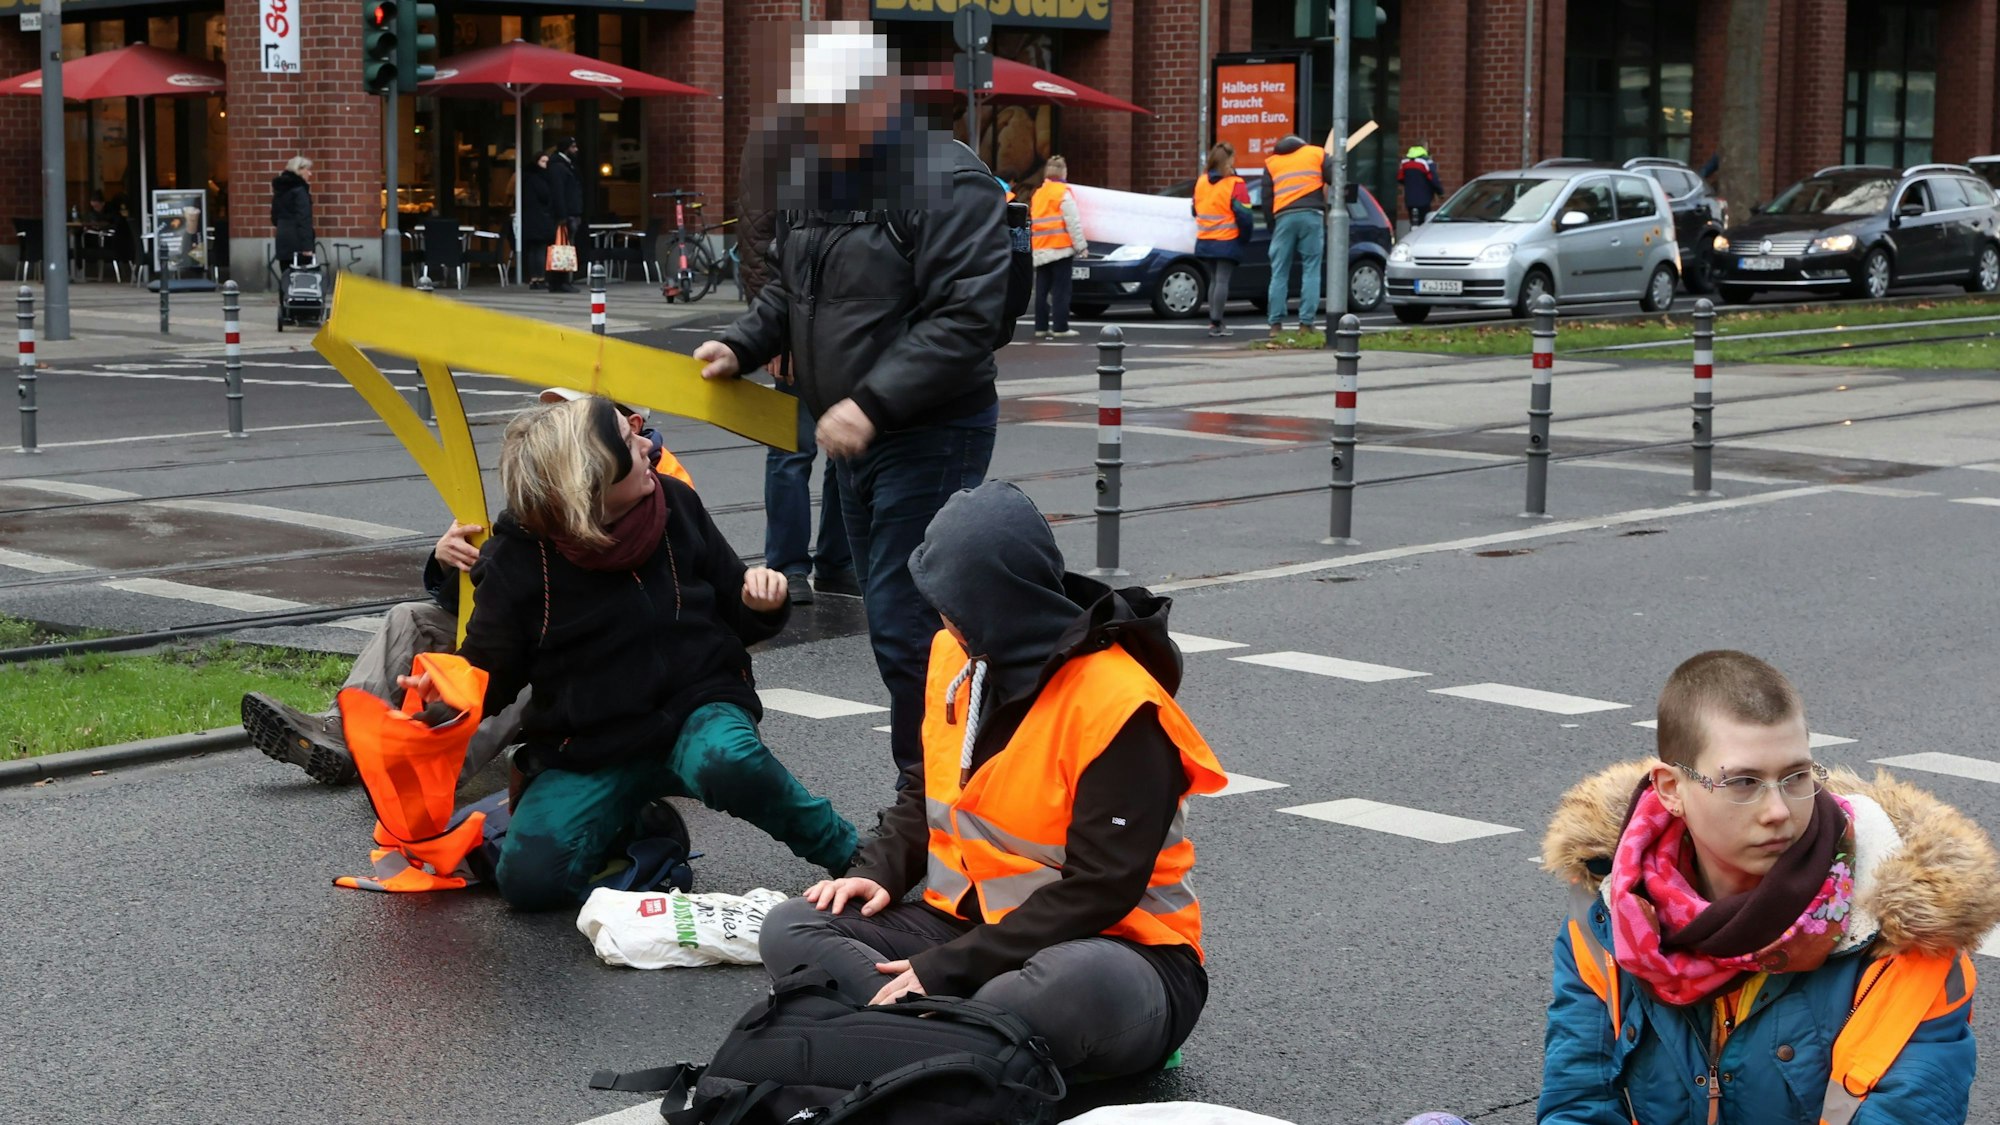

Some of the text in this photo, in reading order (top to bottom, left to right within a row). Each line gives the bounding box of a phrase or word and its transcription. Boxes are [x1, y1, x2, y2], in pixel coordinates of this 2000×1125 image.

[1222, 81, 1286, 93] Halbes Herz
[1221, 96, 1264, 108] braucht
[1221, 111, 1289, 127] ganzen Euro.
